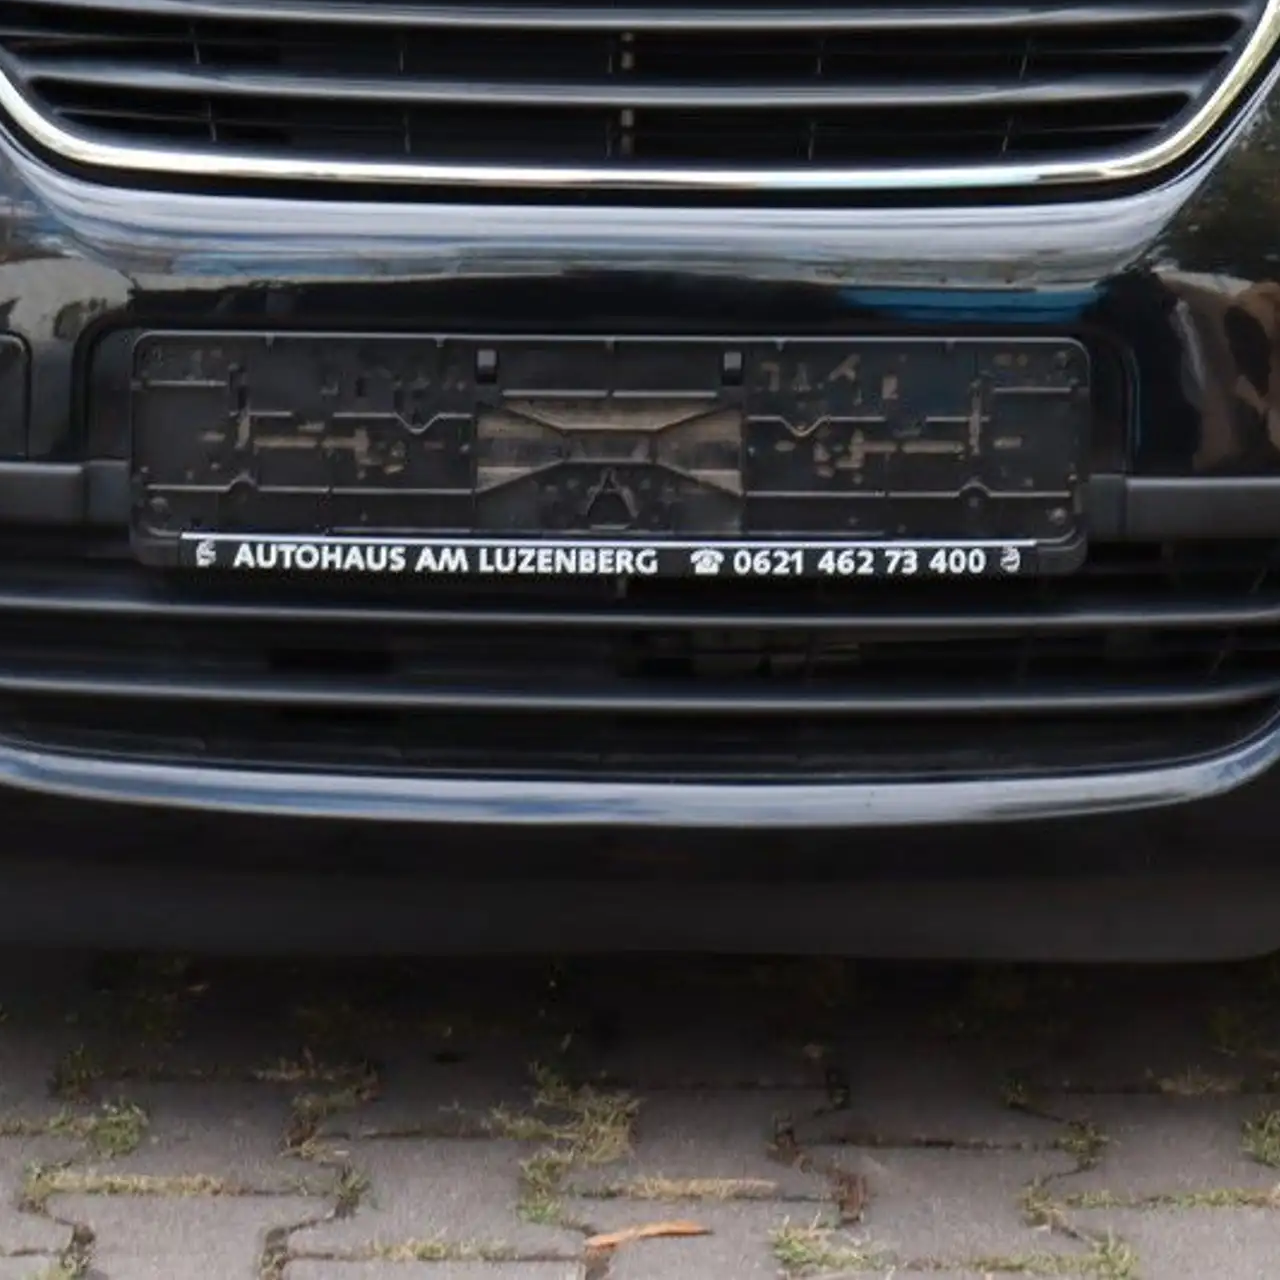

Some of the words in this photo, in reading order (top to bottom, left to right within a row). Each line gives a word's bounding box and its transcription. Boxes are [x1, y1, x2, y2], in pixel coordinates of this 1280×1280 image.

[232, 542, 406, 573] AUTOHAUS
[417, 545, 469, 574] AM
[477, 547, 659, 575] LUZENBERG
[732, 548, 804, 575] 0621
[817, 548, 875, 575] 462
[884, 548, 918, 575] 73
[928, 548, 987, 574] 400
